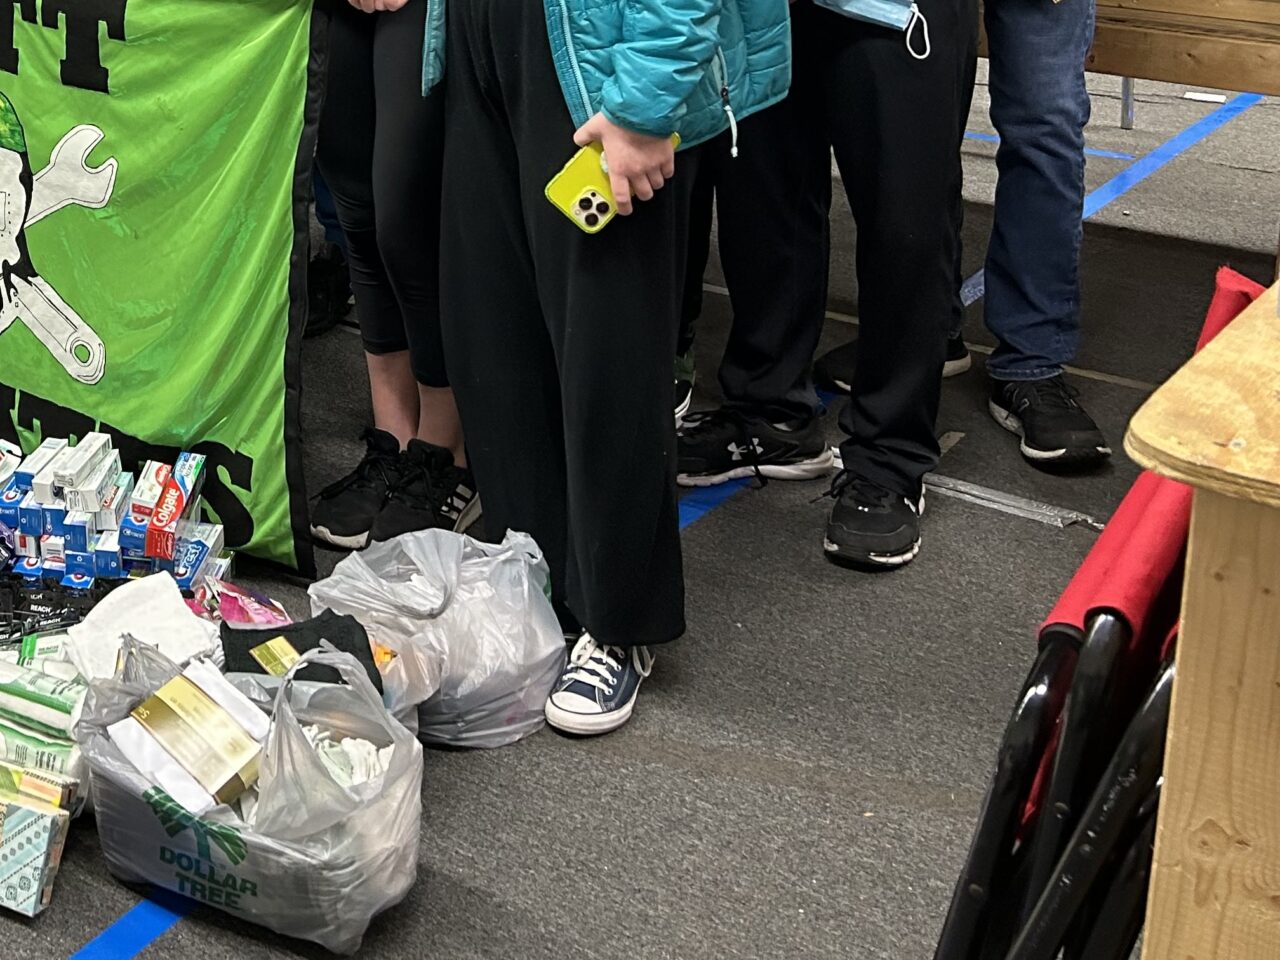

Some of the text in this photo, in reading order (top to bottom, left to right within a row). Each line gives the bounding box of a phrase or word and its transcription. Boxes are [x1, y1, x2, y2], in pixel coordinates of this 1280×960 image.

[152, 488, 180, 527] Colgate
[174, 543, 202, 580] Crest
[159, 845, 258, 897] DOLLAR
[175, 870, 241, 911] TREE
